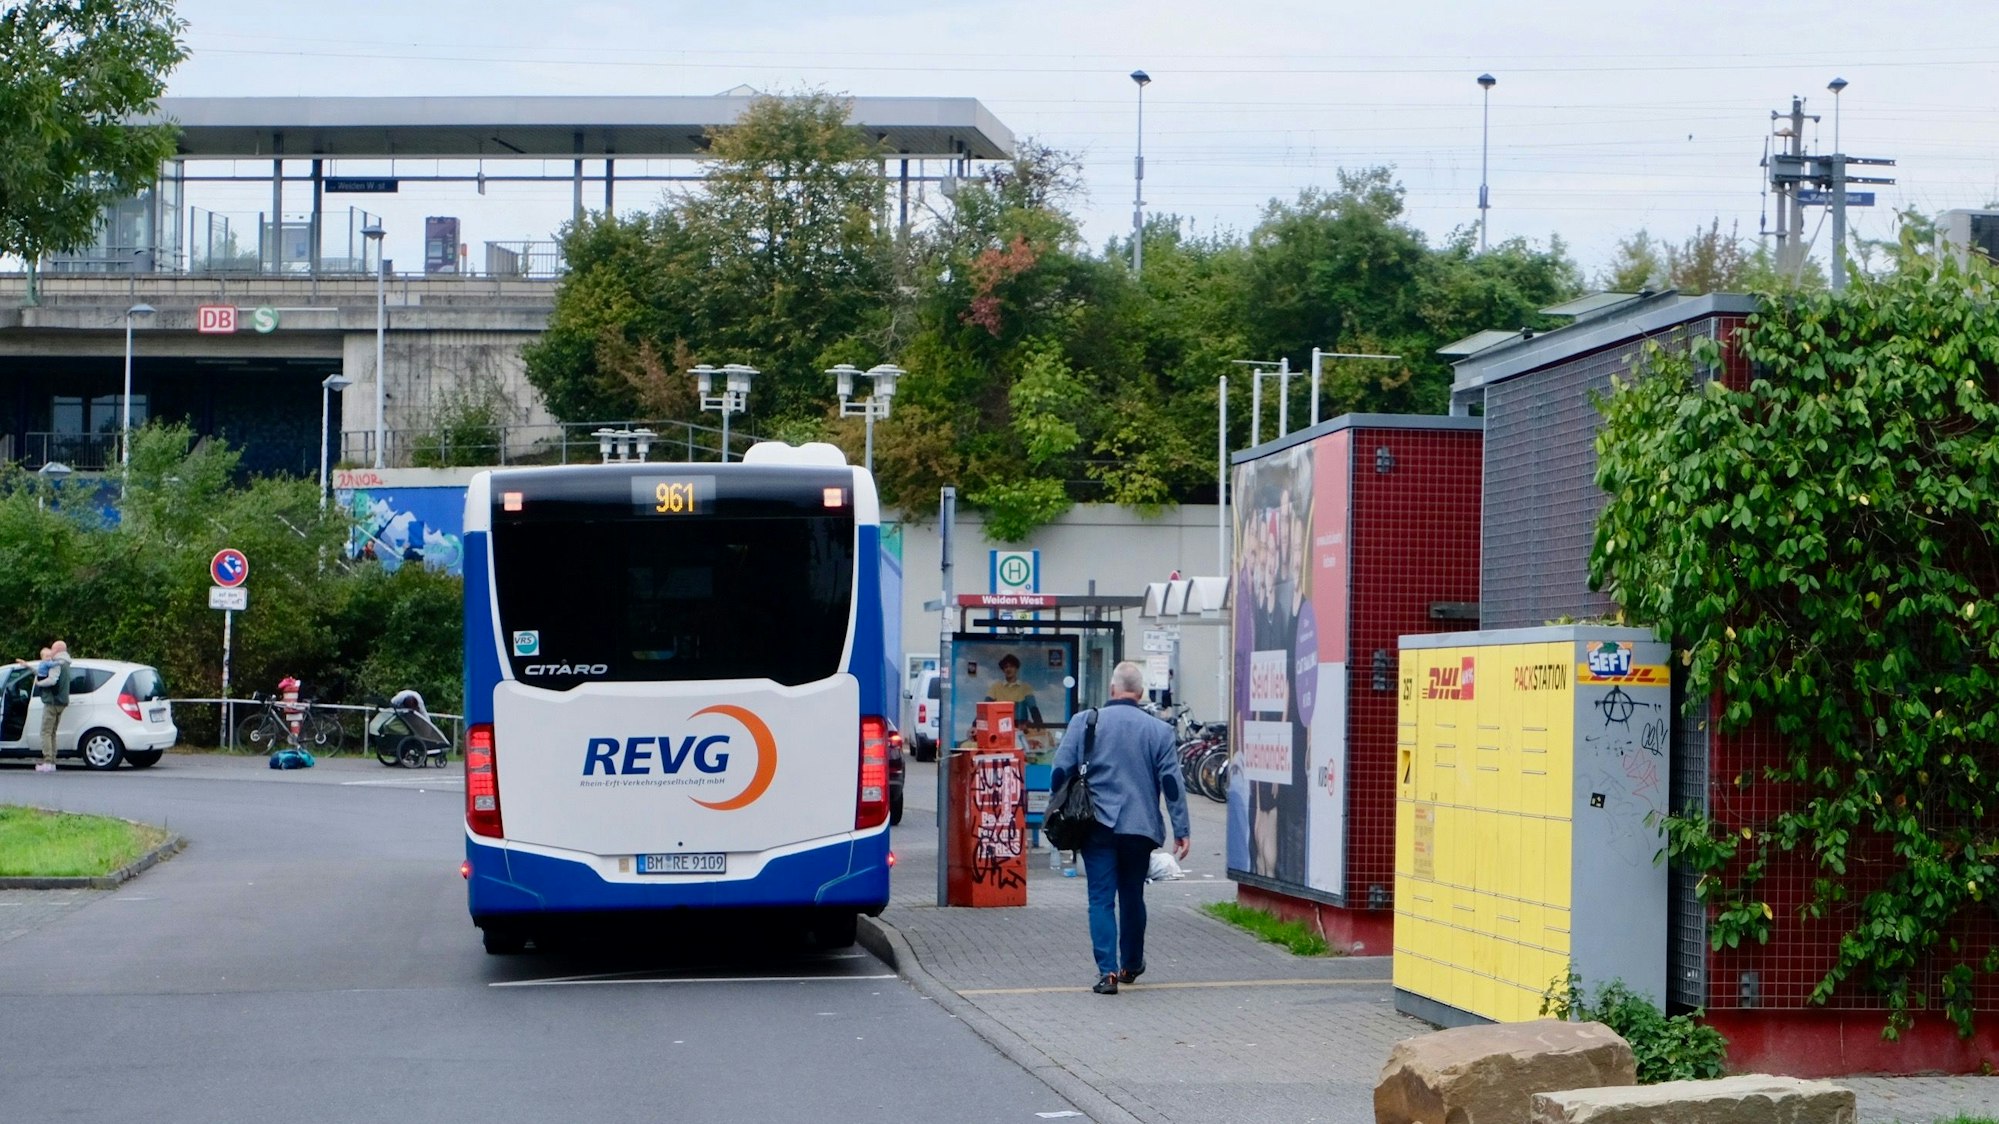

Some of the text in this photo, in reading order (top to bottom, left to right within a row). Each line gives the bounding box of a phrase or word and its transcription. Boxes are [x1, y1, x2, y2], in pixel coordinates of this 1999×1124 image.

[366, 181, 385, 190] Wst
[203, 310, 232, 328] DB
[255, 307, 275, 333] S
[338, 473, 382, 487] JUNIOR
[655, 482, 694, 513] 961
[1008, 562, 1021, 580] H
[982, 595, 1044, 605] Weiden West
[514, 636, 533, 645] VRS
[1589, 648, 1631, 672] SEFT
[525, 663, 608, 676] CITARO
[1252, 662, 1269, 699] Seid
[1270, 662, 1285, 699] lieb
[1427, 667, 1462, 700] DHL
[1514, 664, 1567, 691] PACKSTATION
[582, 734, 731, 776] REVG
[580, 777, 725, 788] Rhein-Erft-Verkehrsgesellschaft mbH
[647, 855, 724, 870] BM RE 9109
